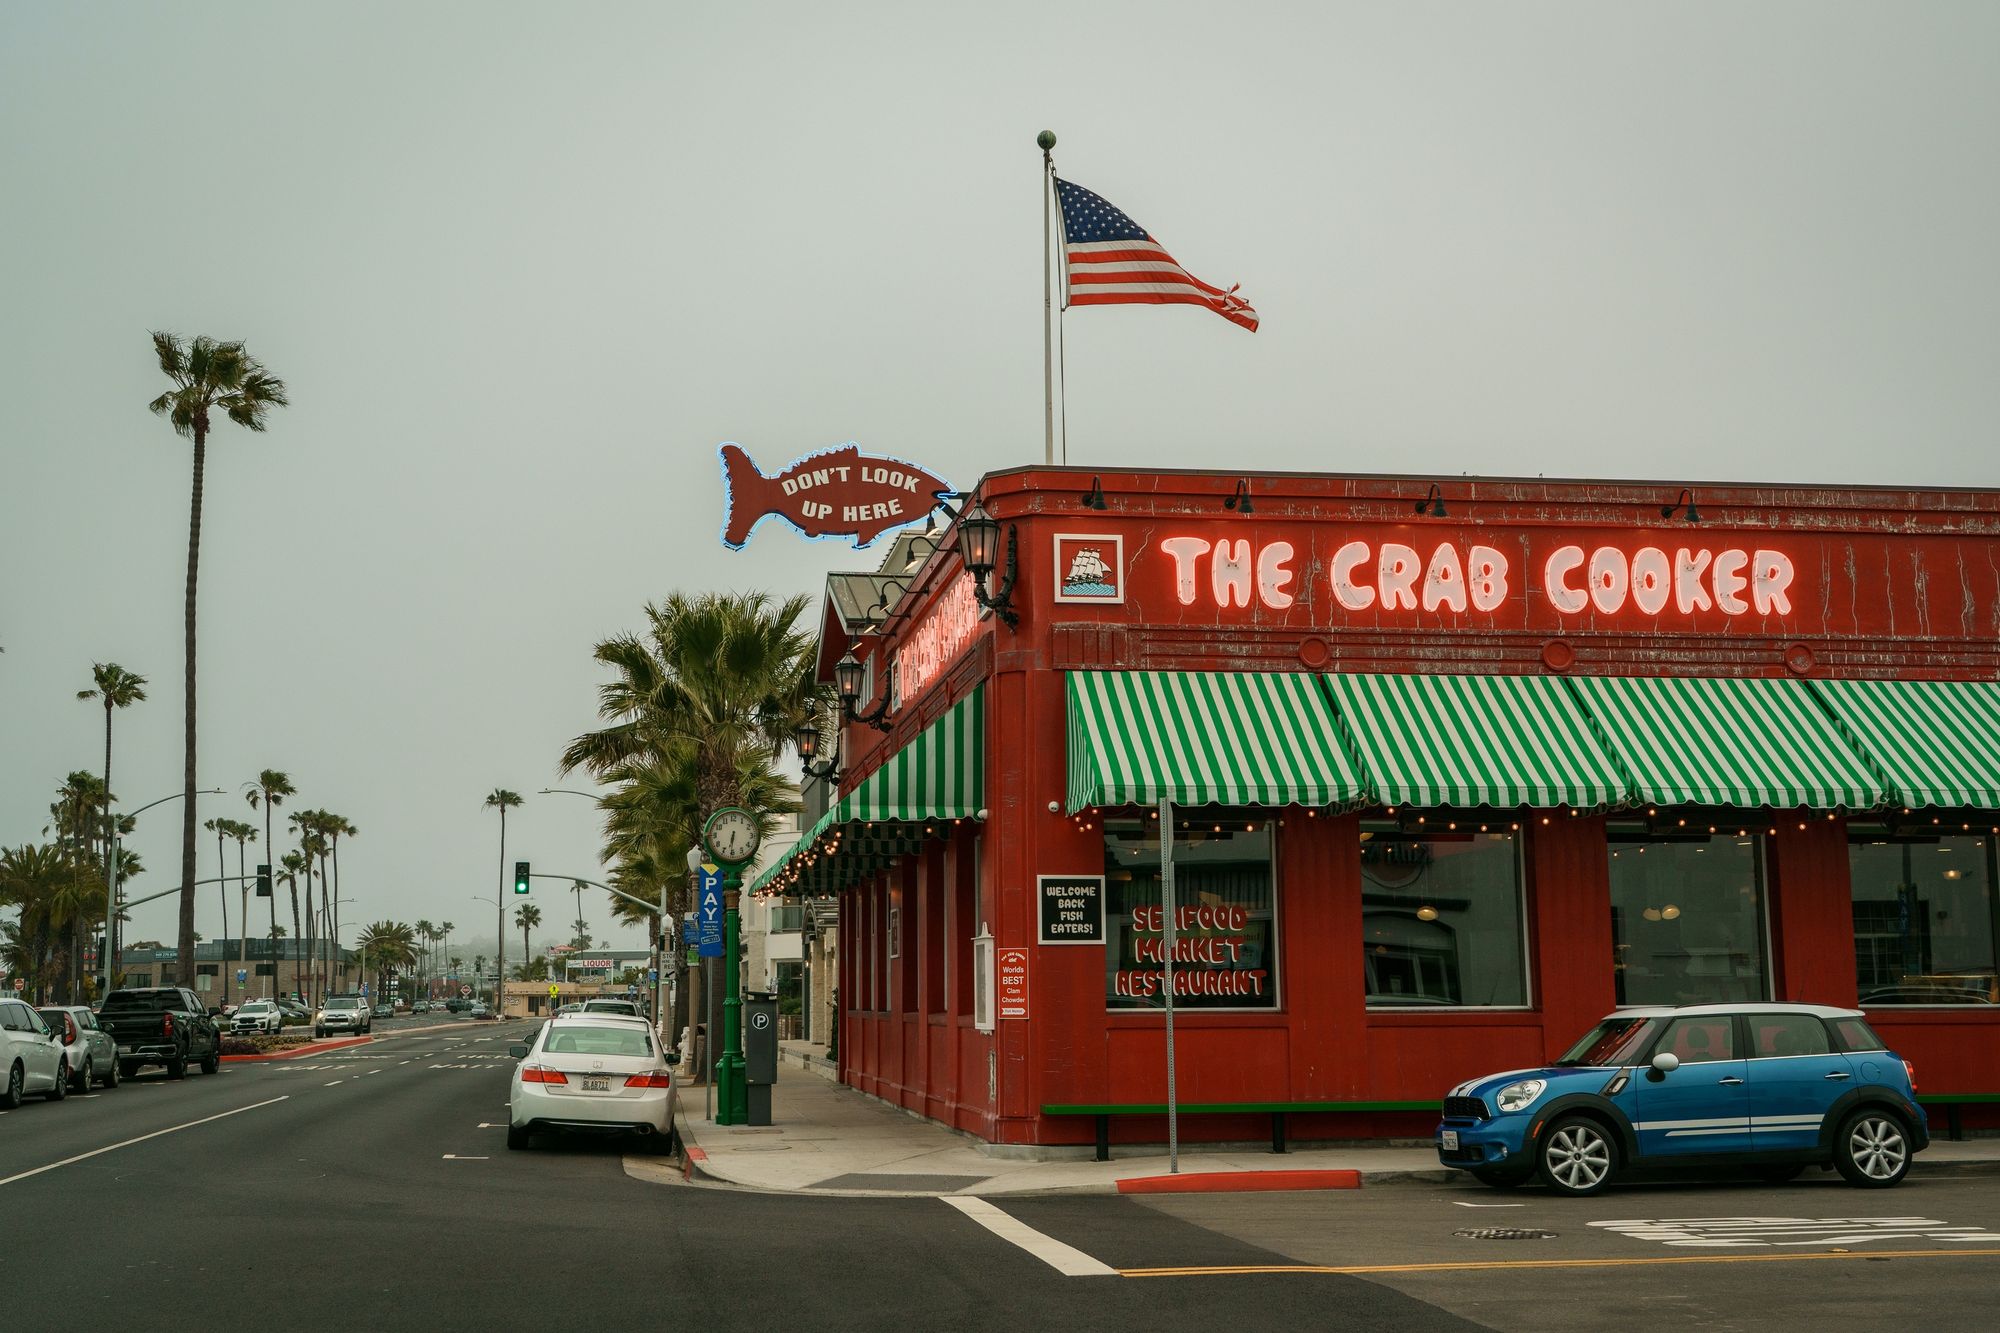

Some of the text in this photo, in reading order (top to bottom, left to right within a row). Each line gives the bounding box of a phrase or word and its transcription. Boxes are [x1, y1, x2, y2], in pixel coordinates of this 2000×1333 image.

[781, 466, 920, 496] DON'T LOOK
[801, 498, 904, 521] UP HERE
[1161, 537, 1794, 615] THE CRAB COOKER
[1046, 886, 1096, 896] WELCOME
[703, 877, 718, 921] PAY
[1058, 899, 1085, 908] BACK
[1060, 911, 1083, 920] FISH
[1051, 923, 1093, 934] EATERS!
[1002, 976, 1024, 984] BEST
